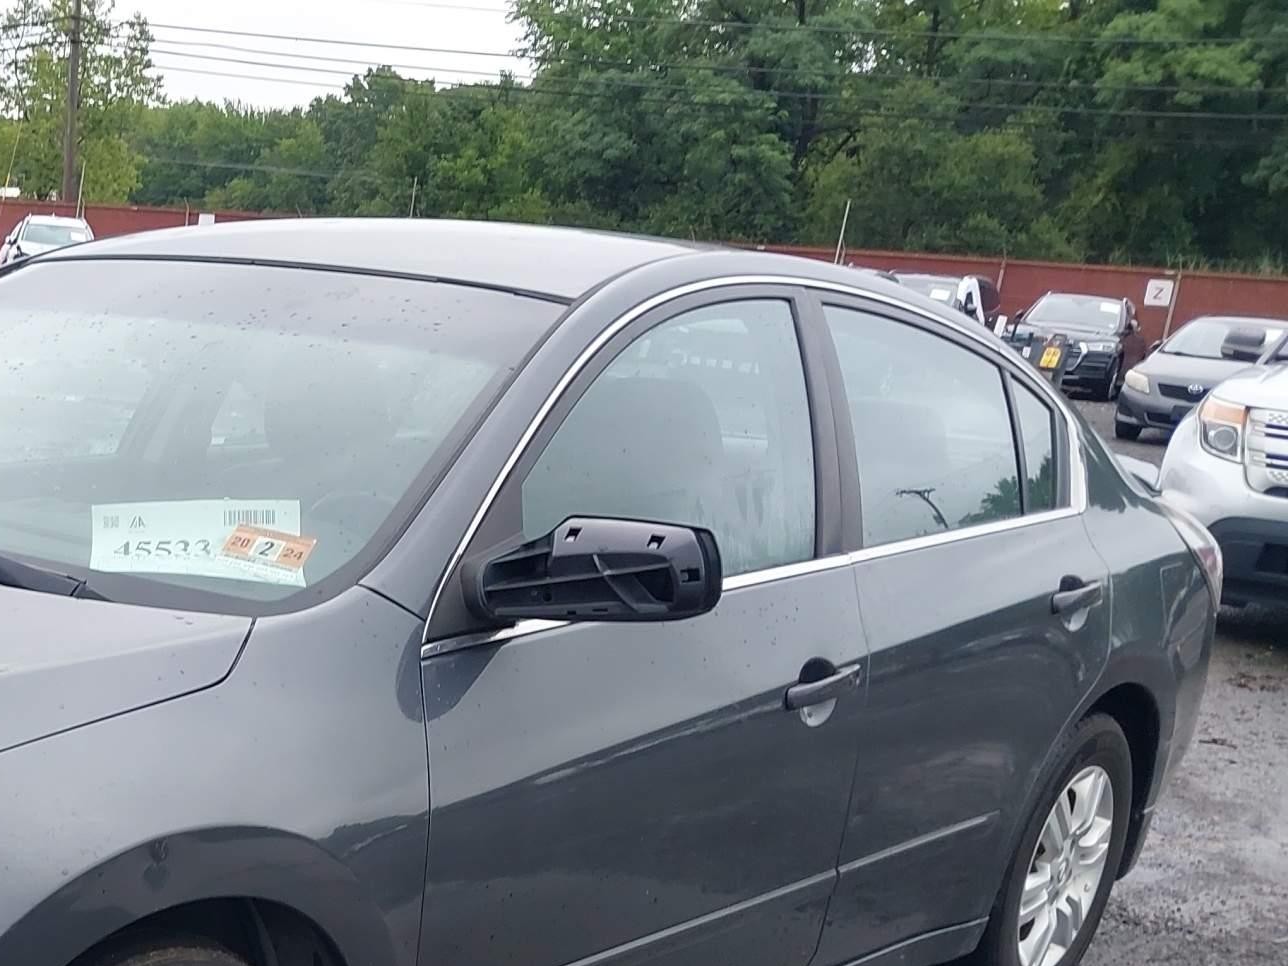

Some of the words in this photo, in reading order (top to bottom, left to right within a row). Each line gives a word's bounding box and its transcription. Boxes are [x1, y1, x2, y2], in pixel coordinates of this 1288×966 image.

[230, 535, 251, 549] 20
[258, 541, 275, 557] 2
[282, 547, 304, 561] 24
